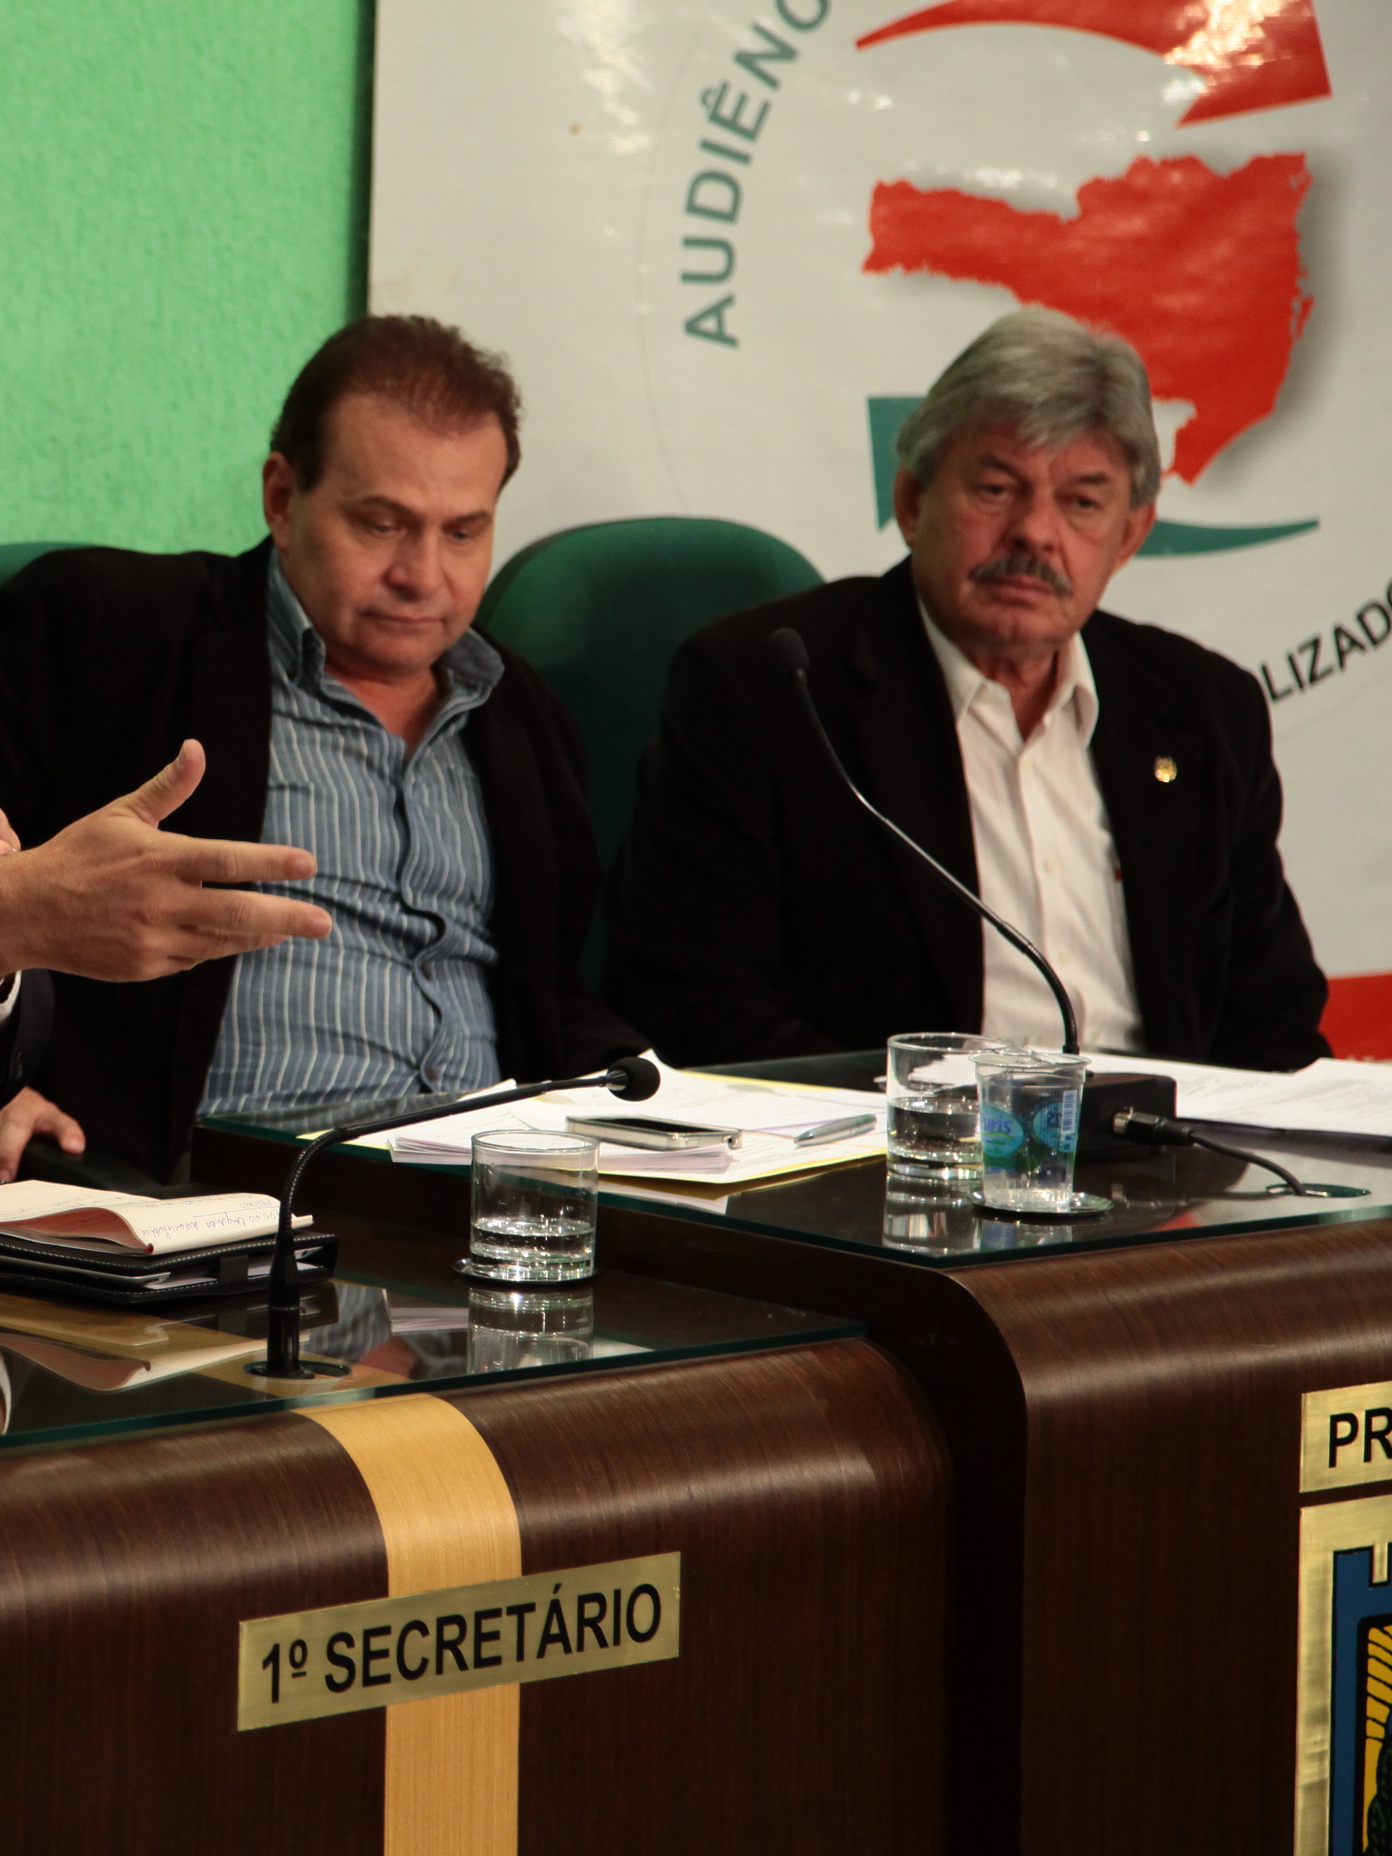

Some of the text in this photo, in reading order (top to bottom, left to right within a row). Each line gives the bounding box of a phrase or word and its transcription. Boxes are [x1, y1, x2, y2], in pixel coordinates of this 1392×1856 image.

[1261, 573, 1392, 702] LIZAD
[982, 1113, 1013, 1135] uris
[1328, 1406, 1392, 1469] PR
[324, 1583, 662, 1694] SECRETÁRIO
